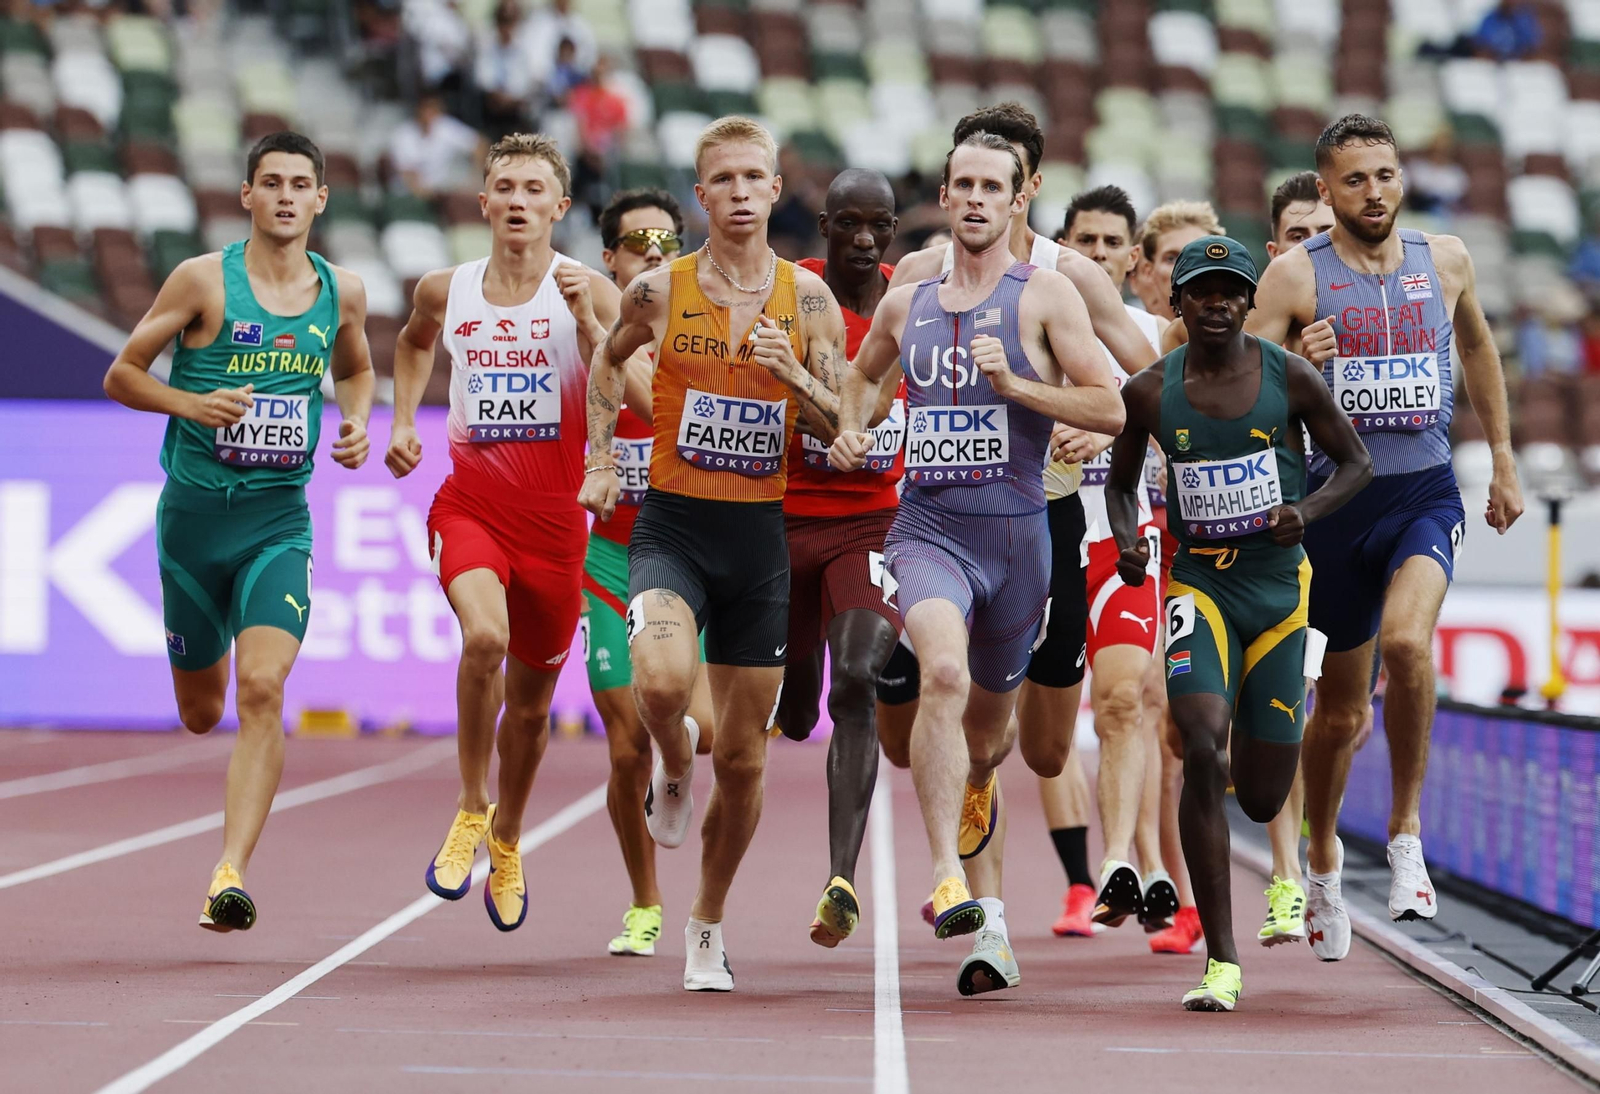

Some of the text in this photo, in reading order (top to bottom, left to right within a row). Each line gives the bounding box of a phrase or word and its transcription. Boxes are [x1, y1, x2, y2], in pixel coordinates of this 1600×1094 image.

[1341, 301, 1425, 332] GREAT
[1337, 328, 1437, 358] BRITAIN
[226, 351, 325, 378] AUSTRALIA
[466, 349, 549, 368] POLSKA
[1364, 357, 1433, 381] TDK
[483, 372, 553, 393] TDK
[253, 397, 303, 419] TDK
[478, 399, 537, 421] RAK
[1340, 385, 1436, 412] GOURLEY
[716, 398, 783, 426] TDK
[927, 409, 999, 433] TDK
[223, 423, 304, 447] MYERS
[685, 422, 782, 454] FARKEN
[909, 438, 1002, 464] HOCKER
[1198, 454, 1270, 488] TDK
[1182, 480, 1278, 518] MPHAHLELE
[647, 619, 681, 627] WHATEVER
[1169, 603, 1184, 637] 6
[652, 632, 673, 640] TAKES
